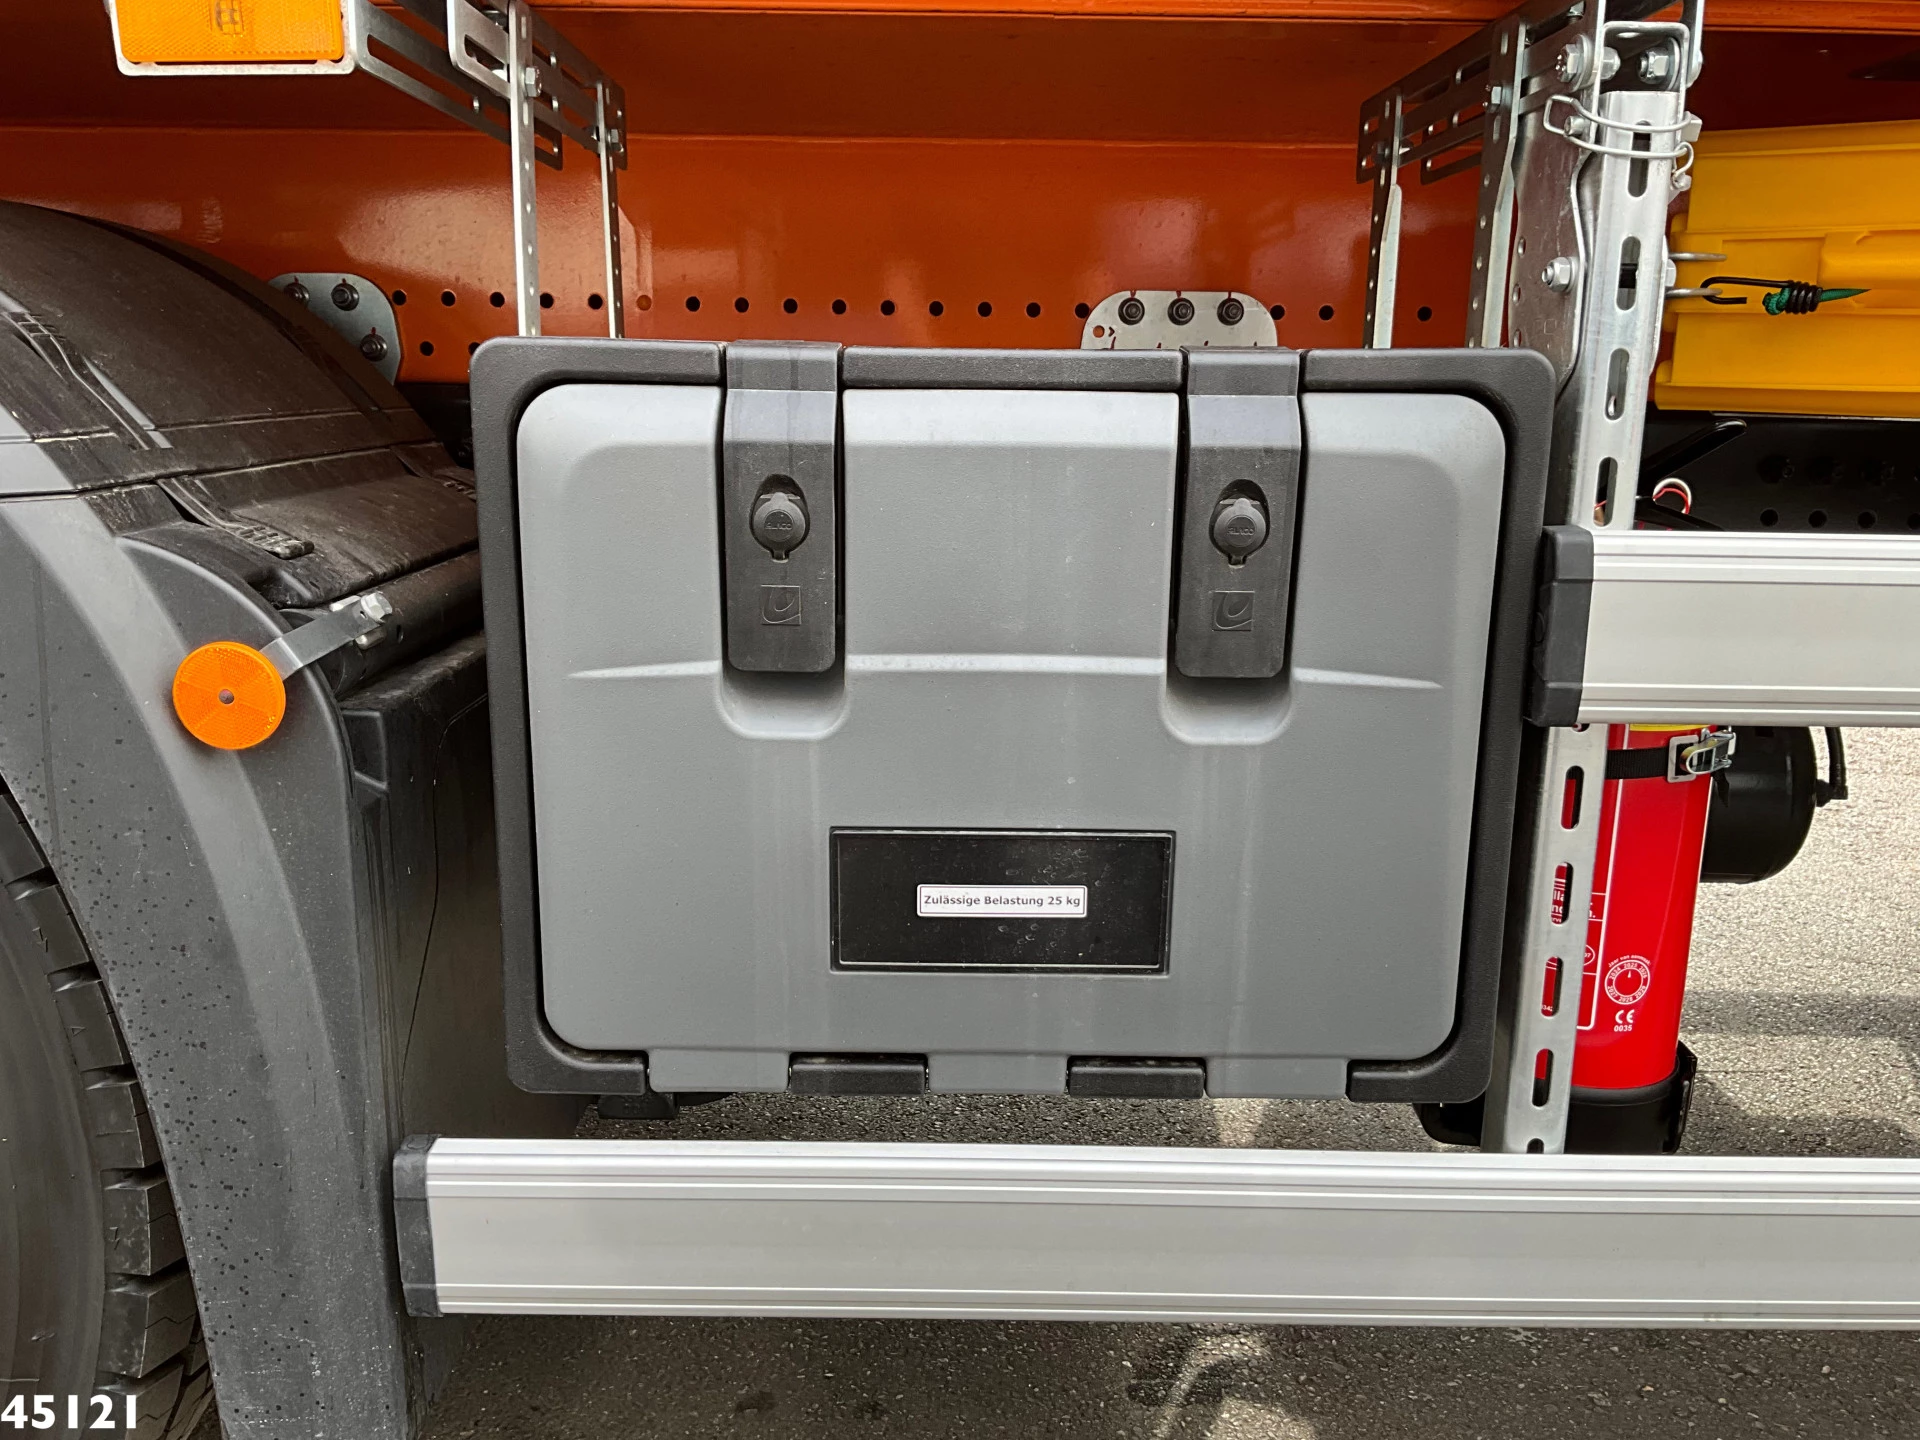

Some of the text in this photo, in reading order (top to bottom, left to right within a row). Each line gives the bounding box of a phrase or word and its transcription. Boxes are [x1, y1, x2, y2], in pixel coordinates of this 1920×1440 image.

[924, 895, 1080, 908] Zulässige Belastung 25 kg
[1615, 1009, 1635, 1024] CE
[1613, 1024, 1633, 1032] 0035
